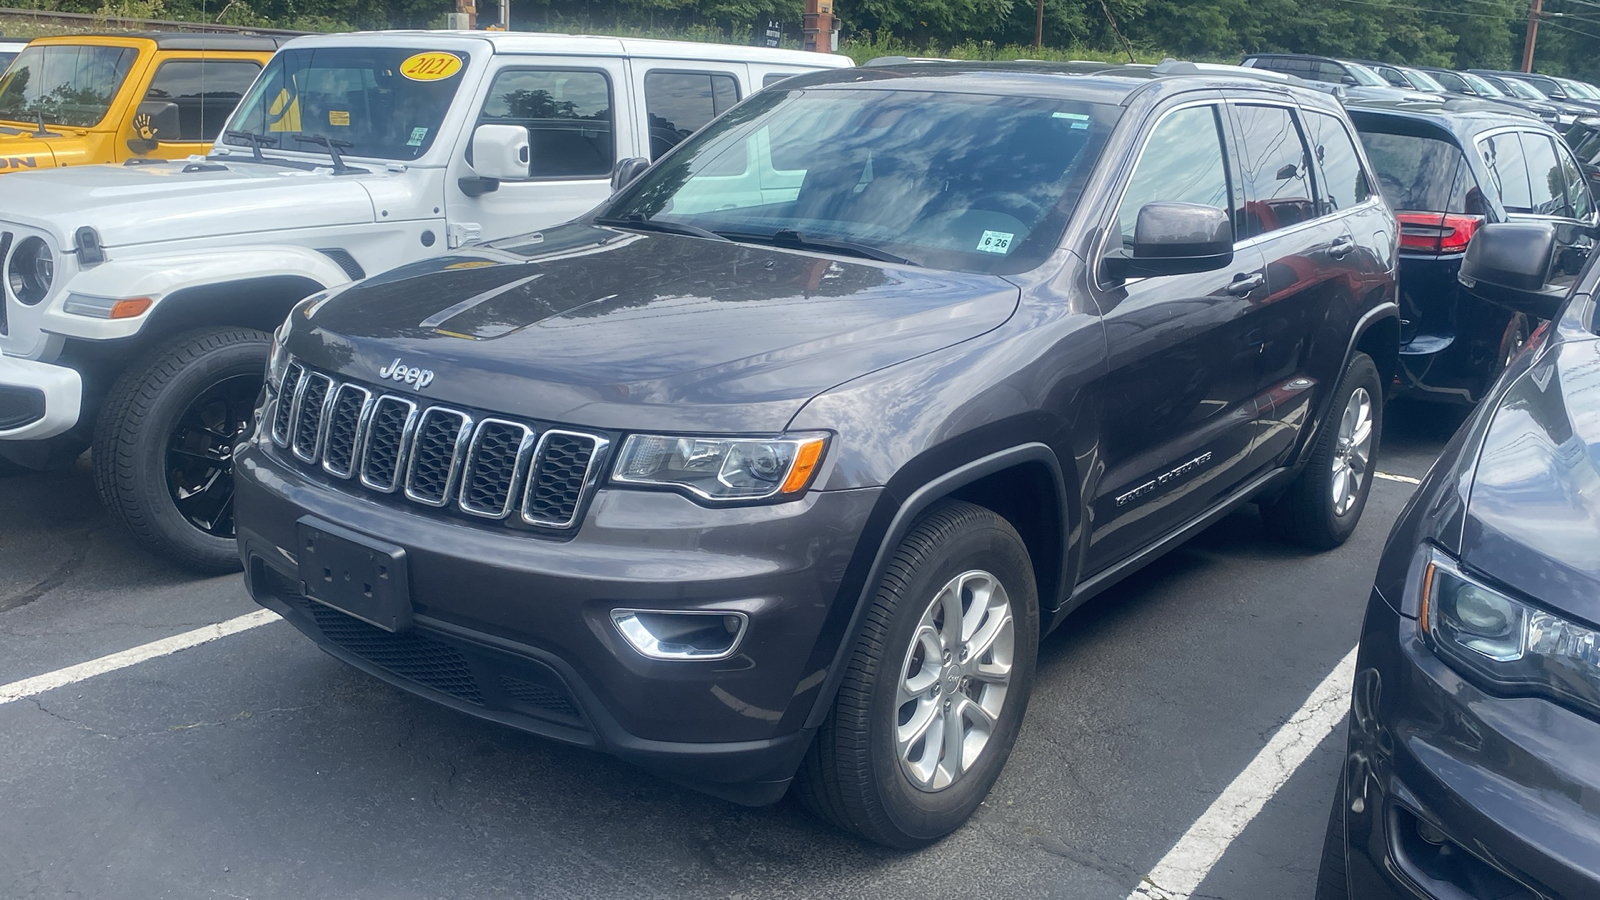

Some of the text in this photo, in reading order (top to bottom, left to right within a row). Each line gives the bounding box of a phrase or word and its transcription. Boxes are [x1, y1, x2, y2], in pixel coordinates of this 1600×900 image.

[766, 39, 778, 47] STOP
[407, 57, 454, 74] 2021
[985, 237, 1008, 248] 6 26
[380, 358, 434, 391] Jeep
